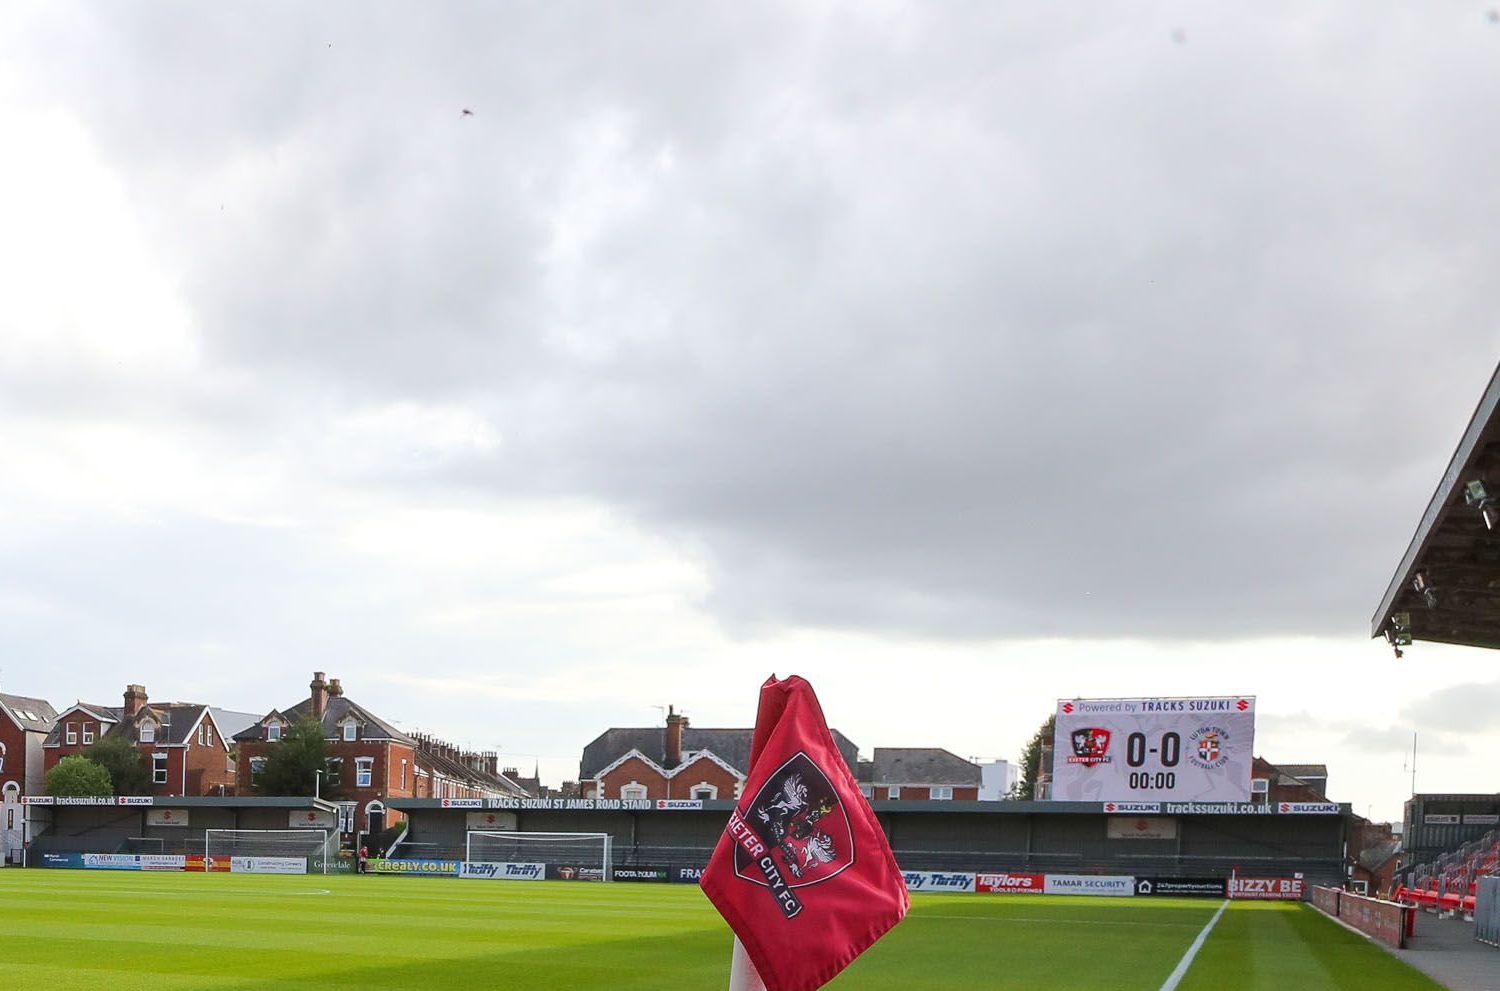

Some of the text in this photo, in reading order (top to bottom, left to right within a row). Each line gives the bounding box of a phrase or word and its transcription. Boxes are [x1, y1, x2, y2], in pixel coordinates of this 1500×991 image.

[1079, 701, 1230, 715] Powered by TRACKS SUZUKI
[1129, 772, 1175, 789] 00:00
[56, 796, 115, 805] trackssuzuki.co.uk
[488, 799, 651, 810] TRACKS SUZUKI ST JAMES ROAD STAND
[1166, 802, 1272, 814] trackssuzuki.co.uk
[314, 860, 350, 869] Grendale
[727, 811, 797, 913] EXETER CITY FC
[463, 863, 542, 879] Thrifty Thrifty
[680, 868, 704, 879] FRA
[931, 874, 975, 890] Thrifty
[977, 874, 1032, 888] Taylors
[1052, 879, 1127, 888] TAMAR SECURITY
[1228, 880, 1302, 893] BIZZY BE
